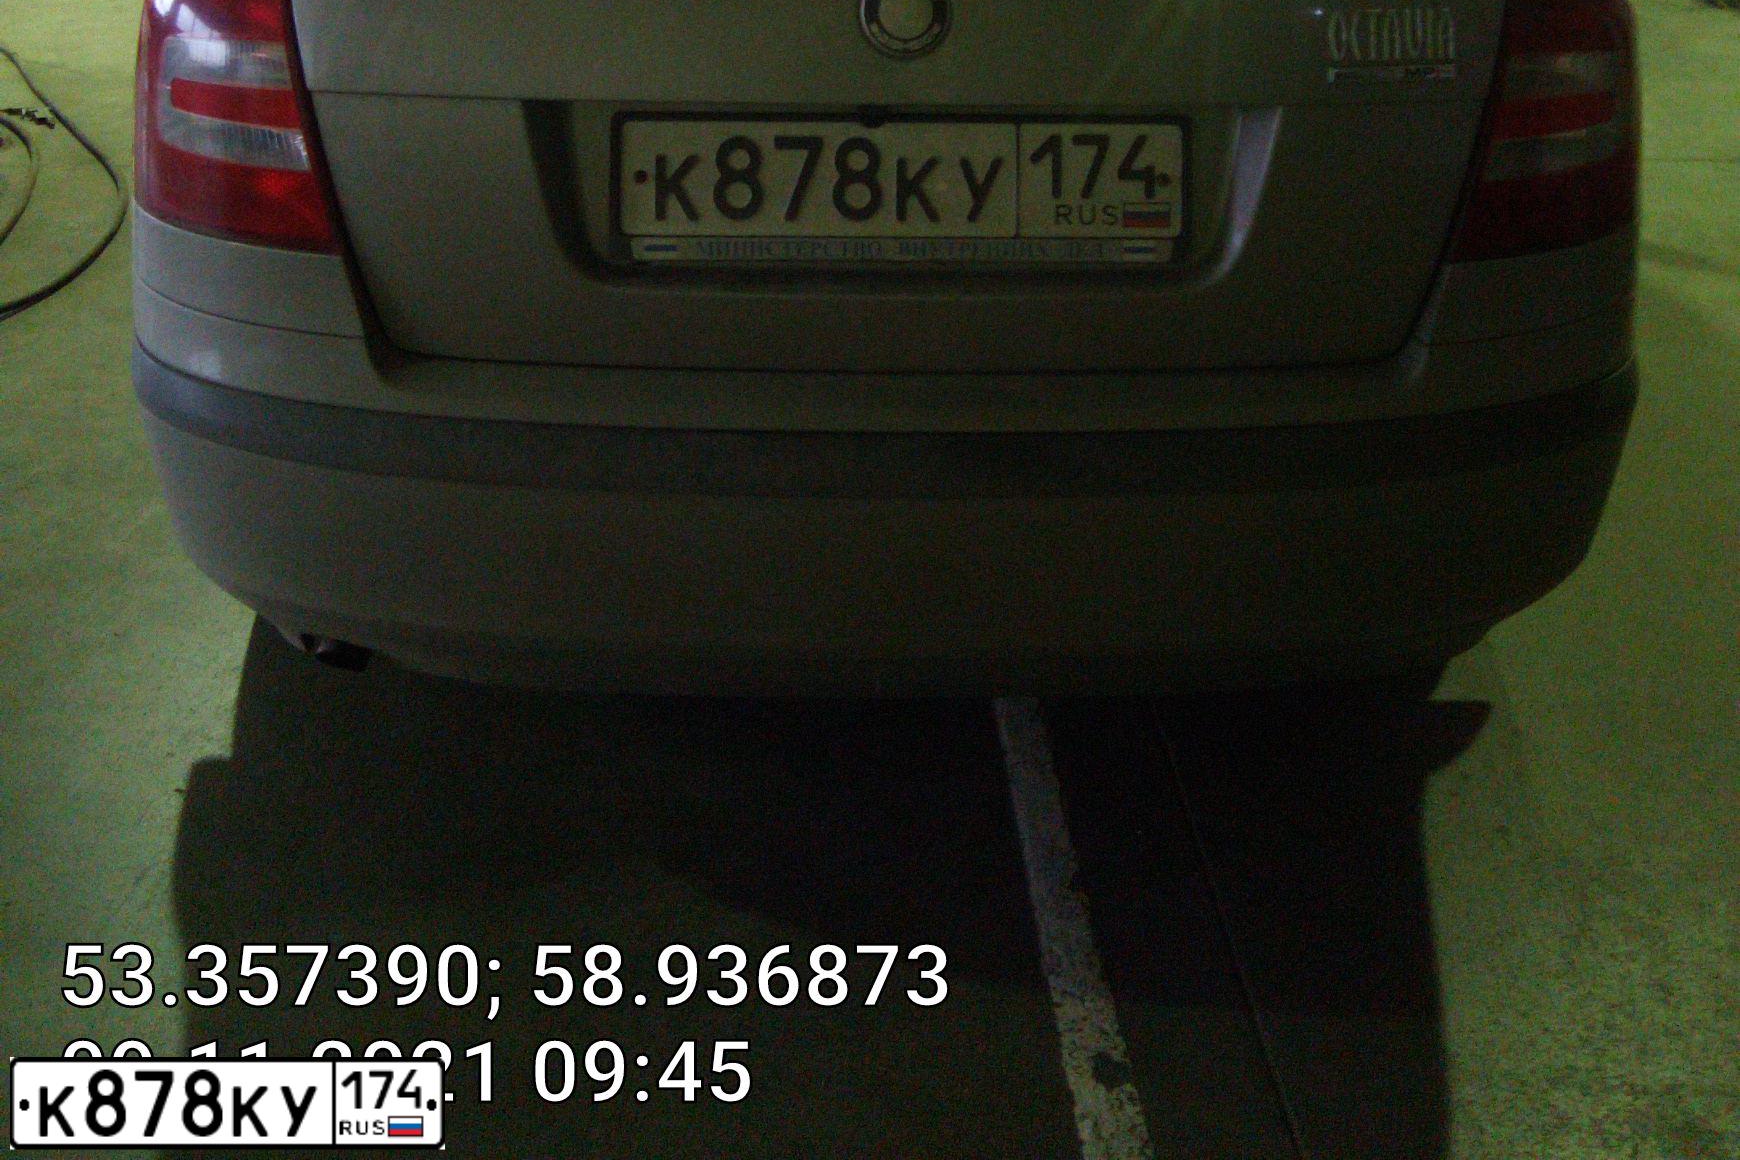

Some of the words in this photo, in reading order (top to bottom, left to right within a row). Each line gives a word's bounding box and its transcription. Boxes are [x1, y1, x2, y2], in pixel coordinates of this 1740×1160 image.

[654, 135, 1003, 223] К878КУ
[1029, 134, 1158, 201] 174
[1053, 202, 1120, 225] RUS
